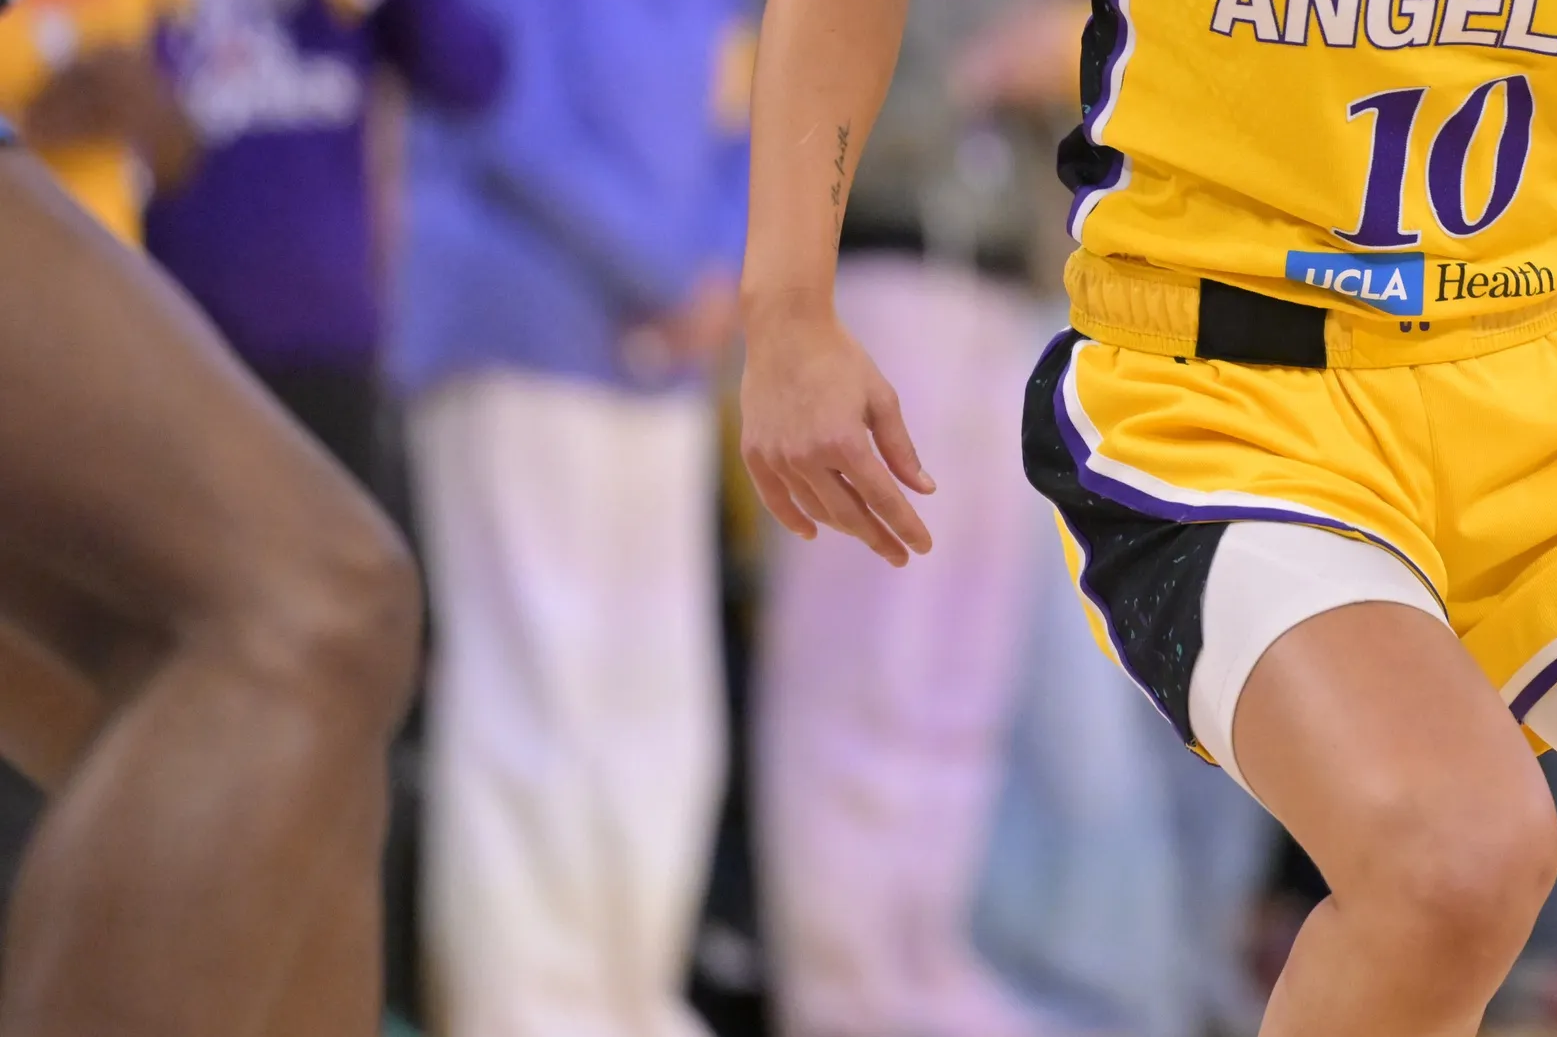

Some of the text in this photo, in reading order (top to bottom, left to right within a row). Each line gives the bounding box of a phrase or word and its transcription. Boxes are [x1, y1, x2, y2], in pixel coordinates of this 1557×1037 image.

[1331, 74, 1534, 249] 10
[1304, 261, 1556, 303] UCLA Health
